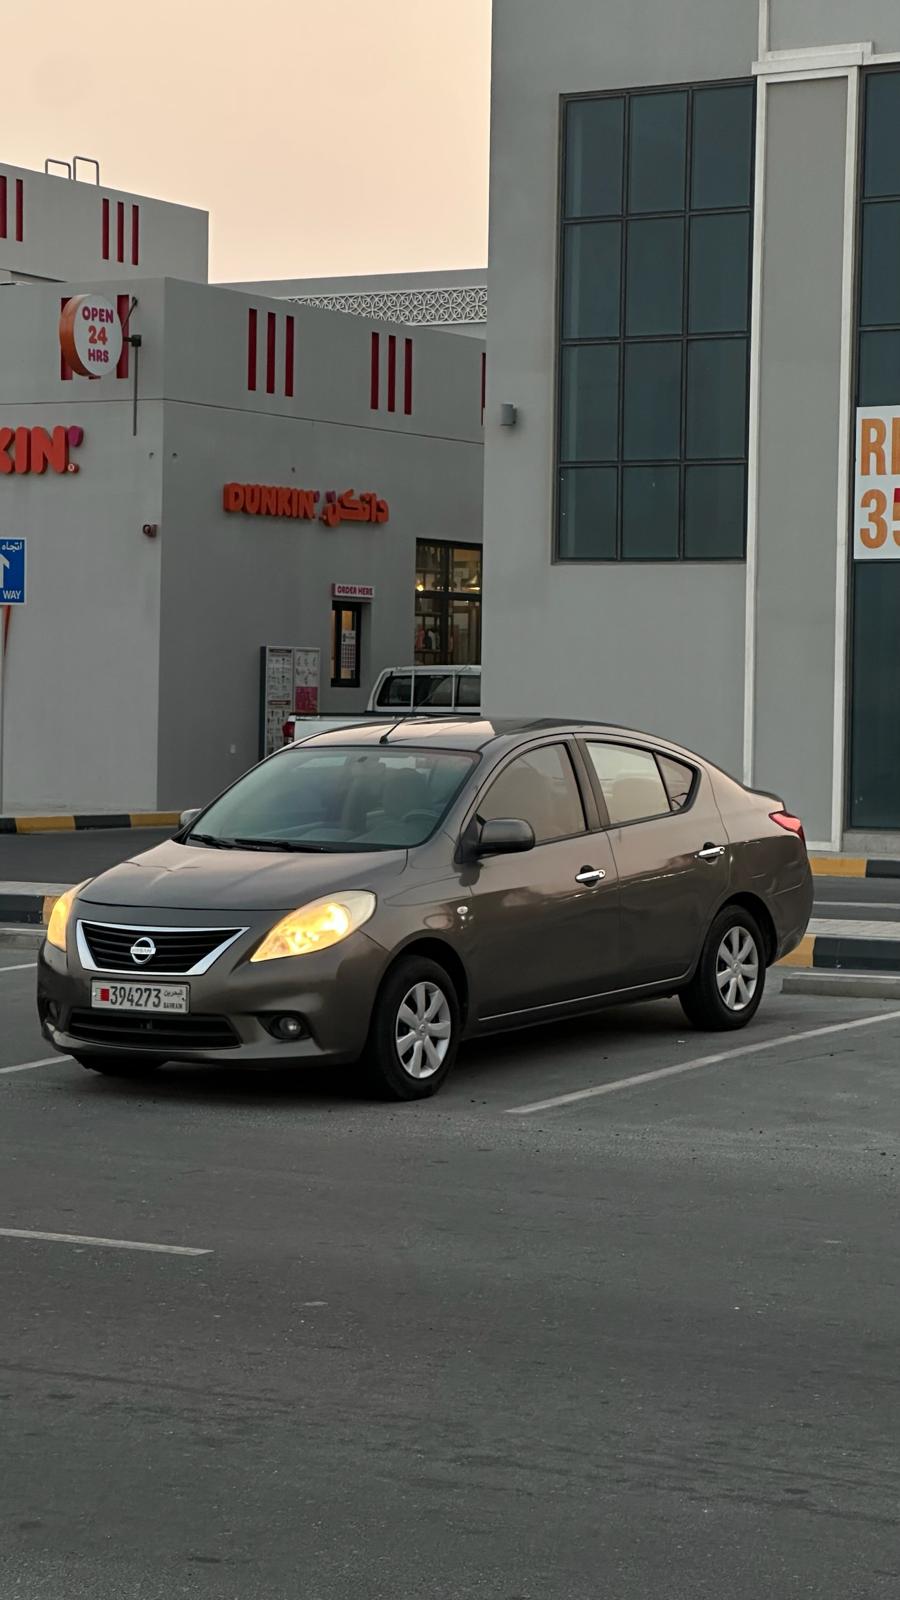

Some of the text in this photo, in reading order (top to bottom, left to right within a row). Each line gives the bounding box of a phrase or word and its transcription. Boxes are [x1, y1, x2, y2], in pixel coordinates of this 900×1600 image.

[82, 306, 114, 323] OPEN
[88, 326, 108, 345] 24
[88, 348, 109, 363] HRS
[1, 541, 23, 552] اتجاه
[2, 590, 21, 599] WAY
[337, 585, 374, 596] ORDER HERE
[110, 986, 161, 1008] 394273
